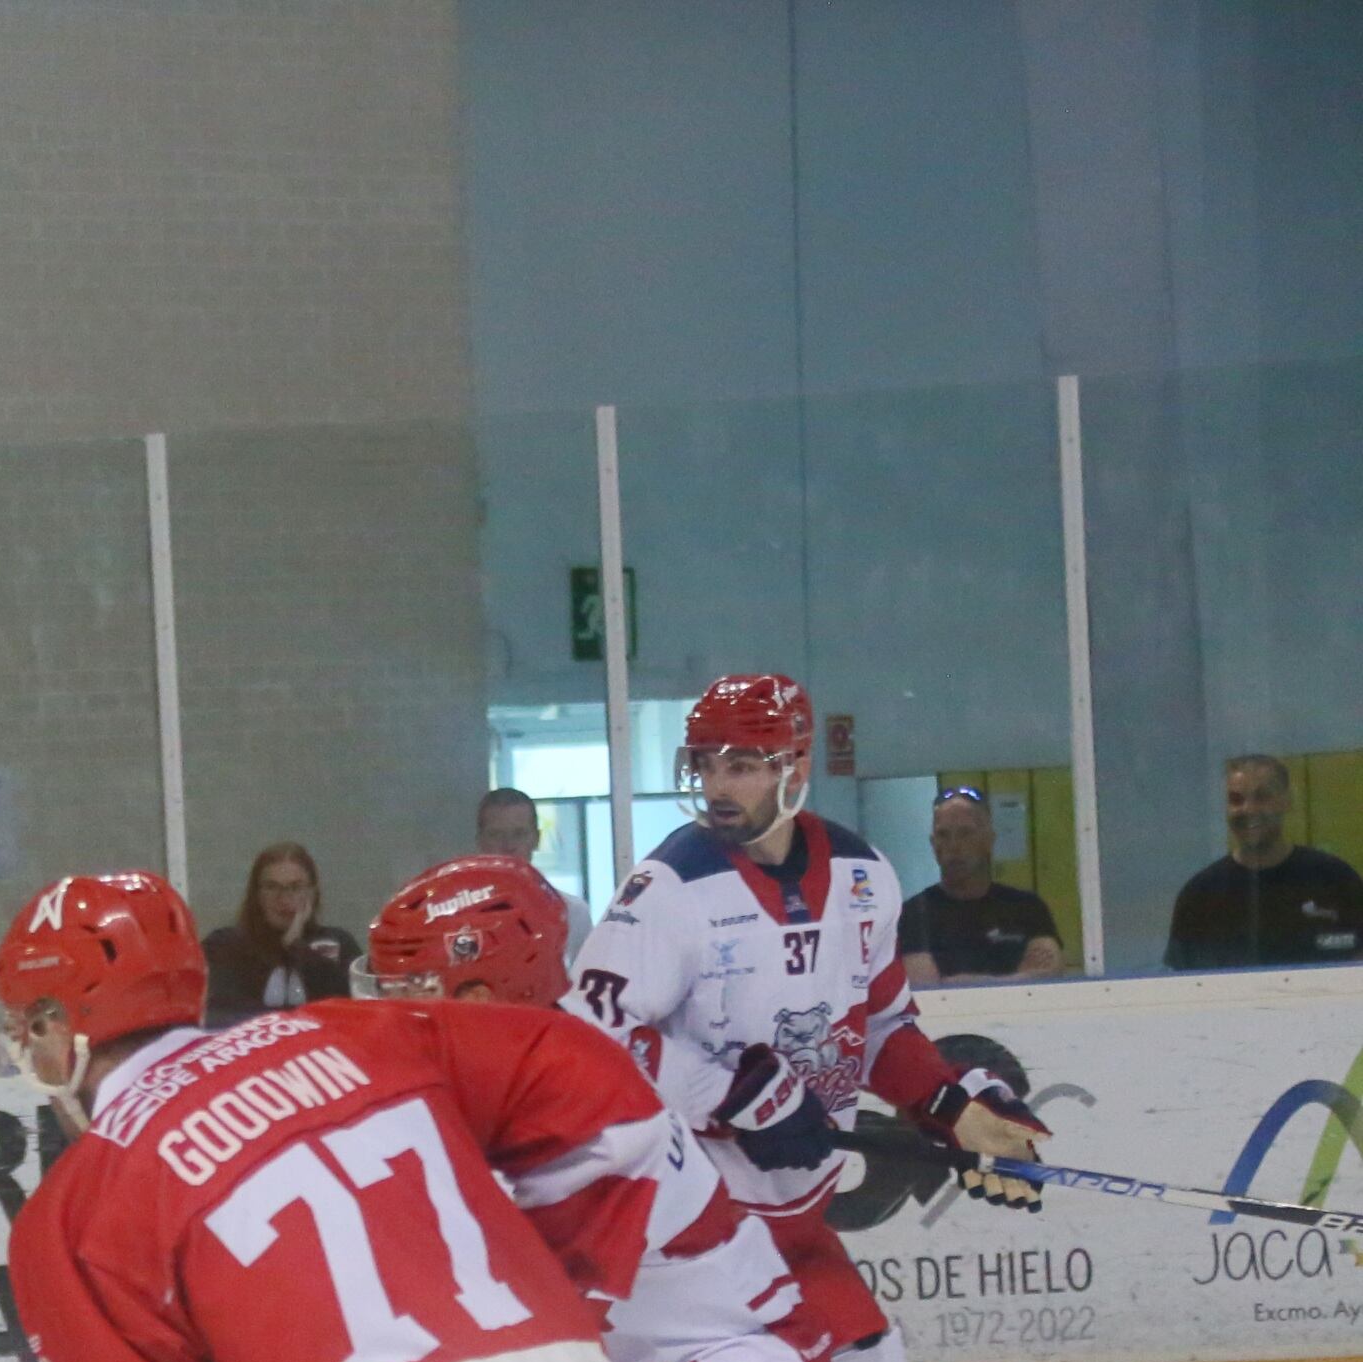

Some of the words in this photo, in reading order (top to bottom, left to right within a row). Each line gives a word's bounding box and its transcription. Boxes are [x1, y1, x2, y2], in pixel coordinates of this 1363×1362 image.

[425, 885, 496, 924] Jupiler
[783, 929, 821, 976] 37
[157, 1046, 371, 1186] GOODWIN
[916, 1255, 965, 1300] DE
[978, 1247, 1093, 1297] HIELO
[935, 1305, 1096, 1348] 1972-2022
[1253, 1302, 1327, 1322] Excmo.
